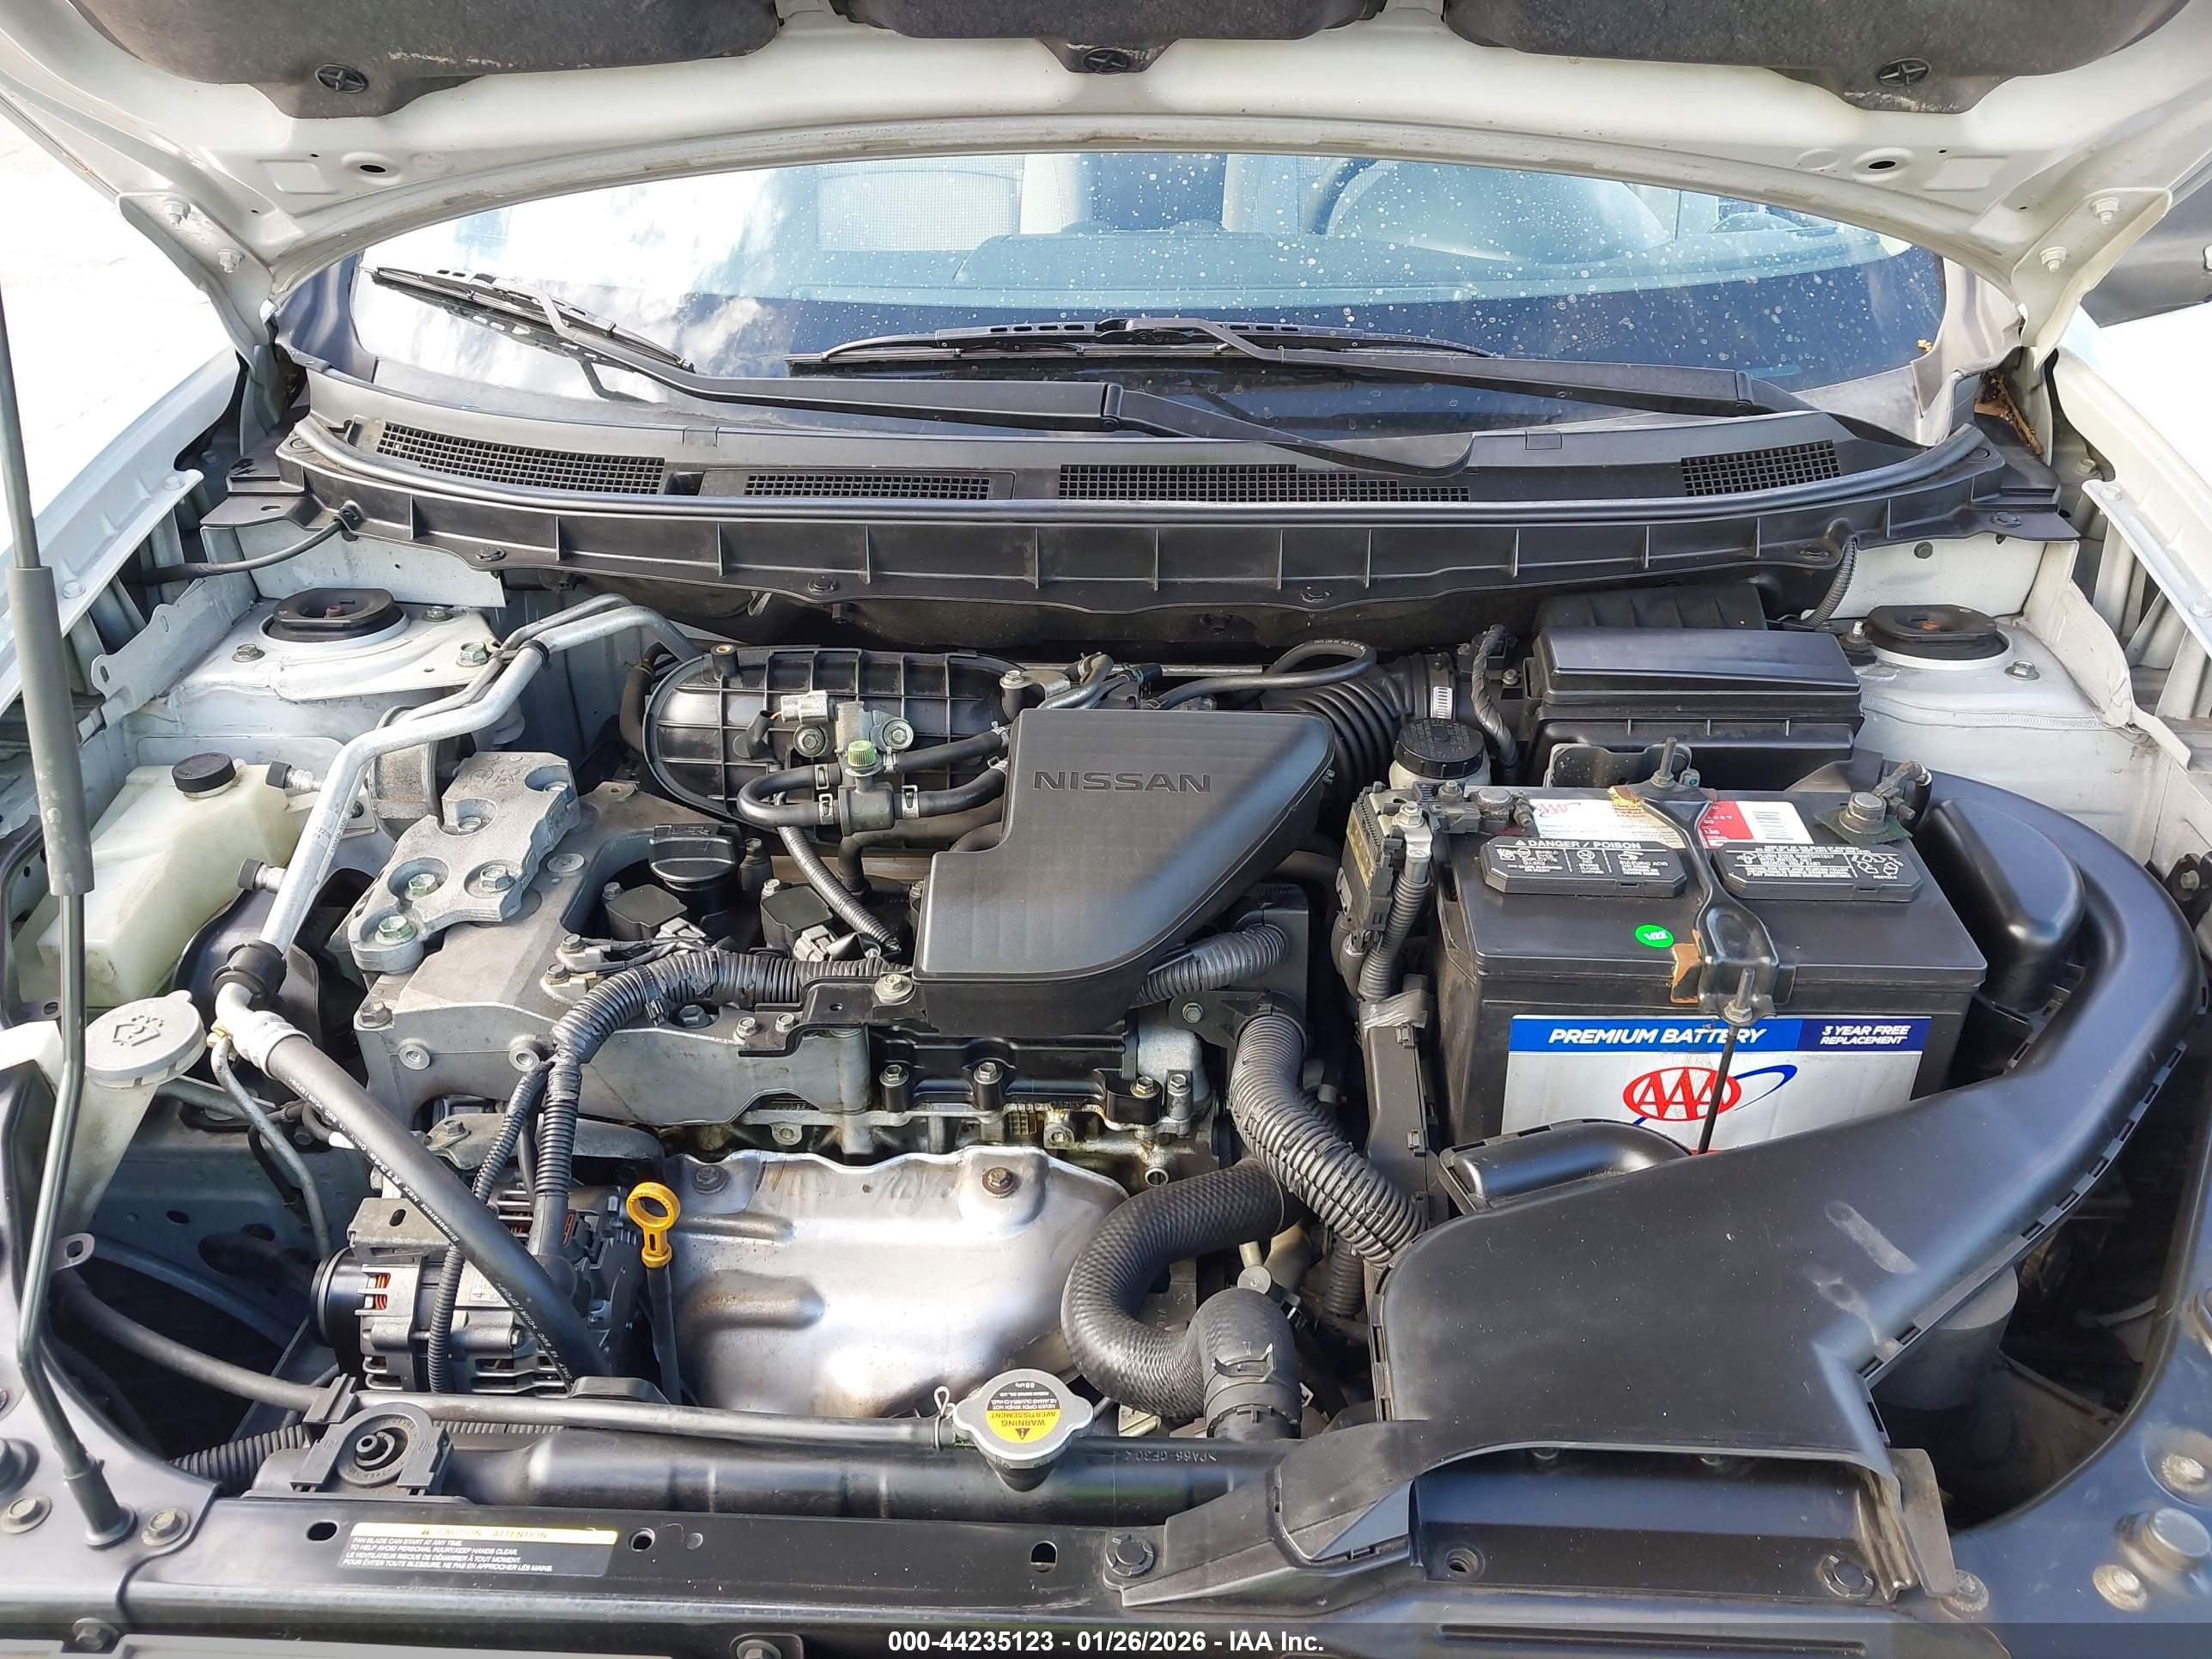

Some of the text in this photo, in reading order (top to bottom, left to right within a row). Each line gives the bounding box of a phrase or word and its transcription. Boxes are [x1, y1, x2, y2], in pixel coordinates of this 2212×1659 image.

[1033, 770, 1211, 793] NISSAN
[1528, 840, 1581, 848] DANGER
[1821, 1025, 1911, 1036] 3 YEAR FREE
[1548, 1028, 1767, 1044] PREMIUM BATTERY
[493, 1529, 548, 1539] ATTENTION
[476, 1563, 517, 1571] APPROCHER
